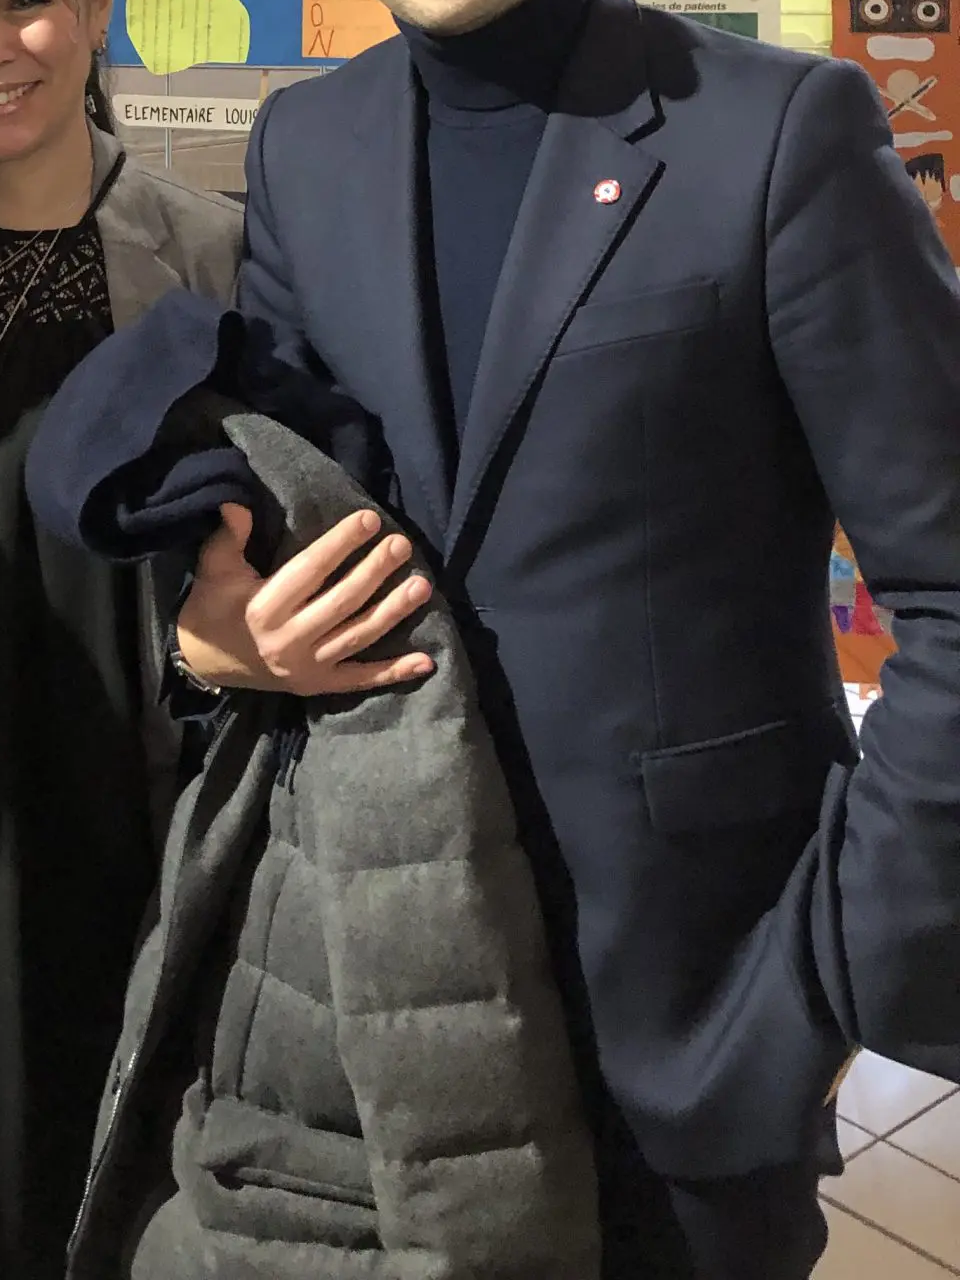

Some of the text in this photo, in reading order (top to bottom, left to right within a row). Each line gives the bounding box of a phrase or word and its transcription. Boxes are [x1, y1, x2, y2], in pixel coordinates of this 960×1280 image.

[669, 1, 682, 11] de
[684, 2, 727, 12] patients
[225, 107, 258, 125] LOUI
